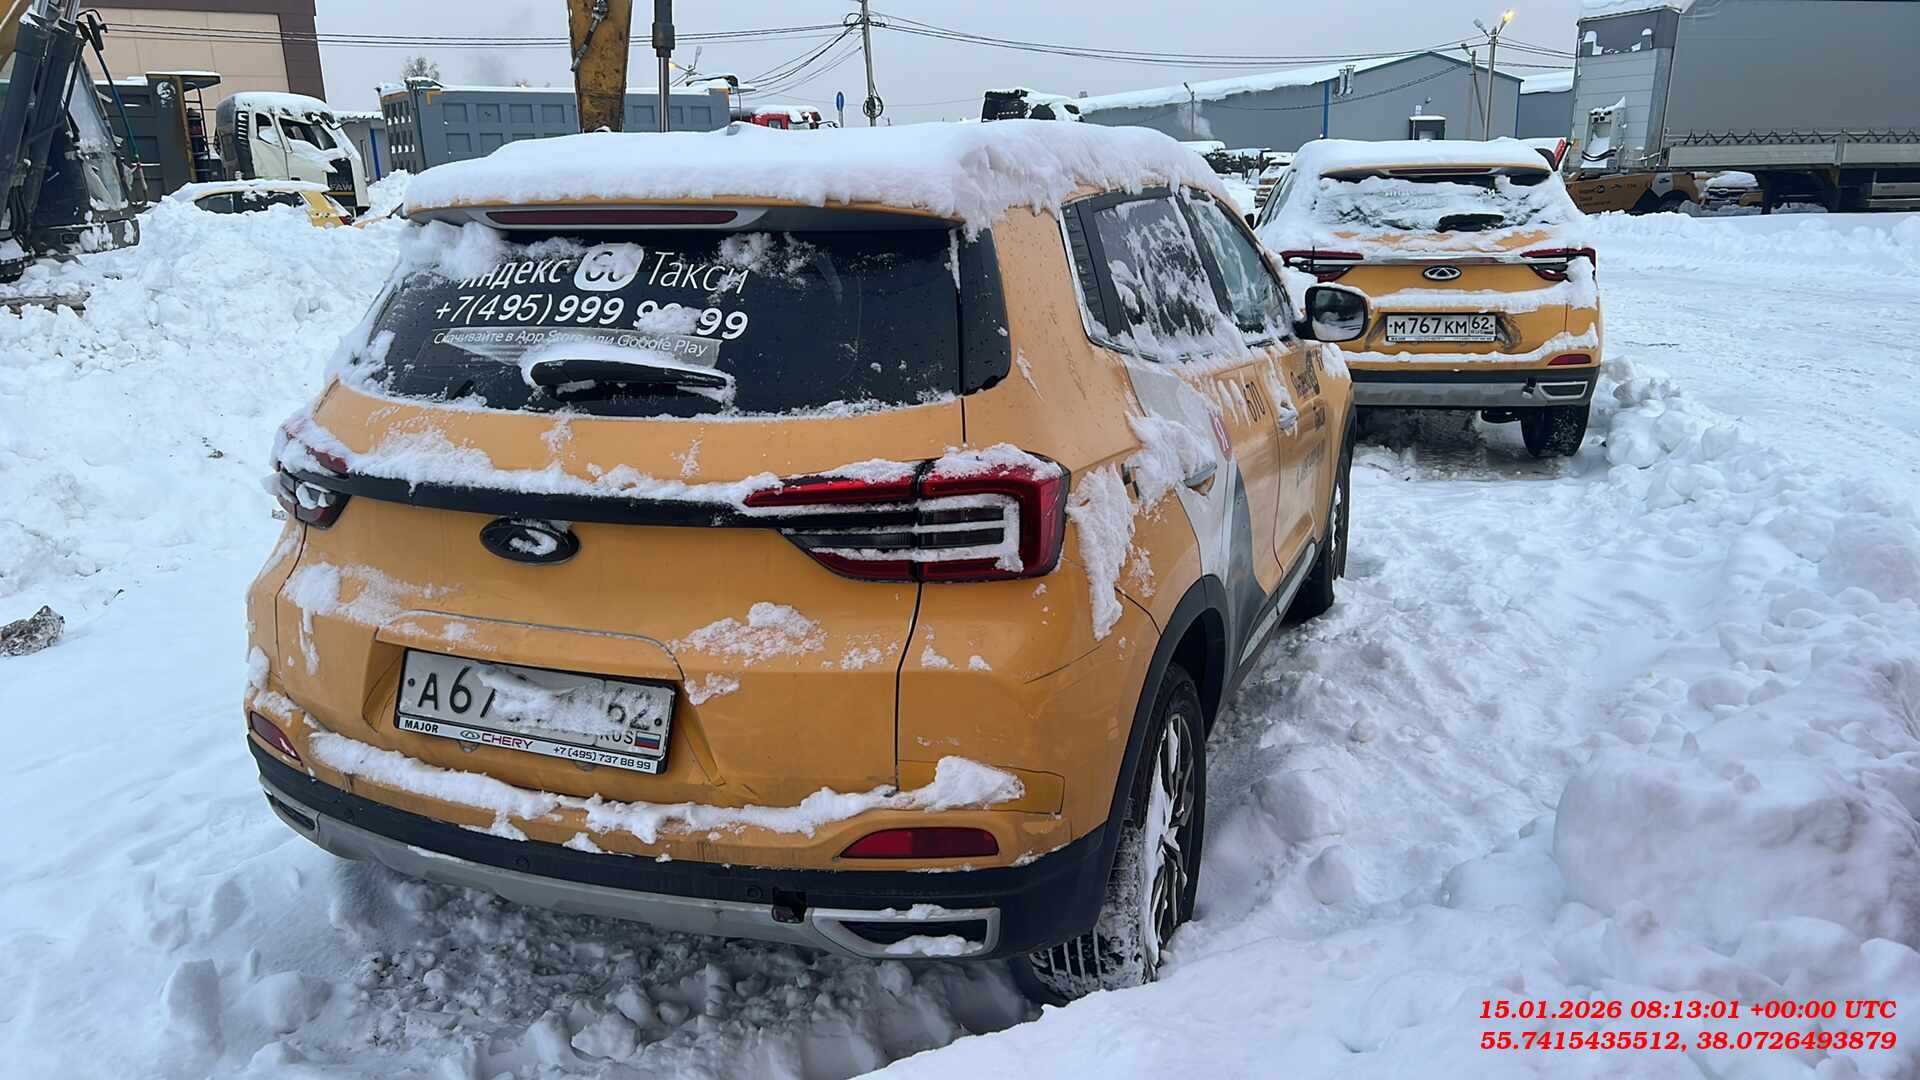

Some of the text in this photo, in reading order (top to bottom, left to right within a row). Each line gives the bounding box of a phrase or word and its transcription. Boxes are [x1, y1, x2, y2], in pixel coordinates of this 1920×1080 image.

[457, 259, 570, 290] ндекс
[647, 251, 750, 295] Такси
[632, 300, 683, 328] 9
[696, 307, 749, 340] 99
[1471, 316, 1489, 330] 62
[433, 329, 503, 345] Скачивайте
[505, 333, 513, 342] в
[516, 330, 545, 344] App
[618, 335, 671, 351] Google
[674, 340, 709, 357] Play
[404, 719, 439, 734] MAJOR
[481, 733, 534, 750] CHERY
[599, 753, 618, 765] 737
[620, 756, 635, 767] 88
[636, 758, 651, 770] 99
